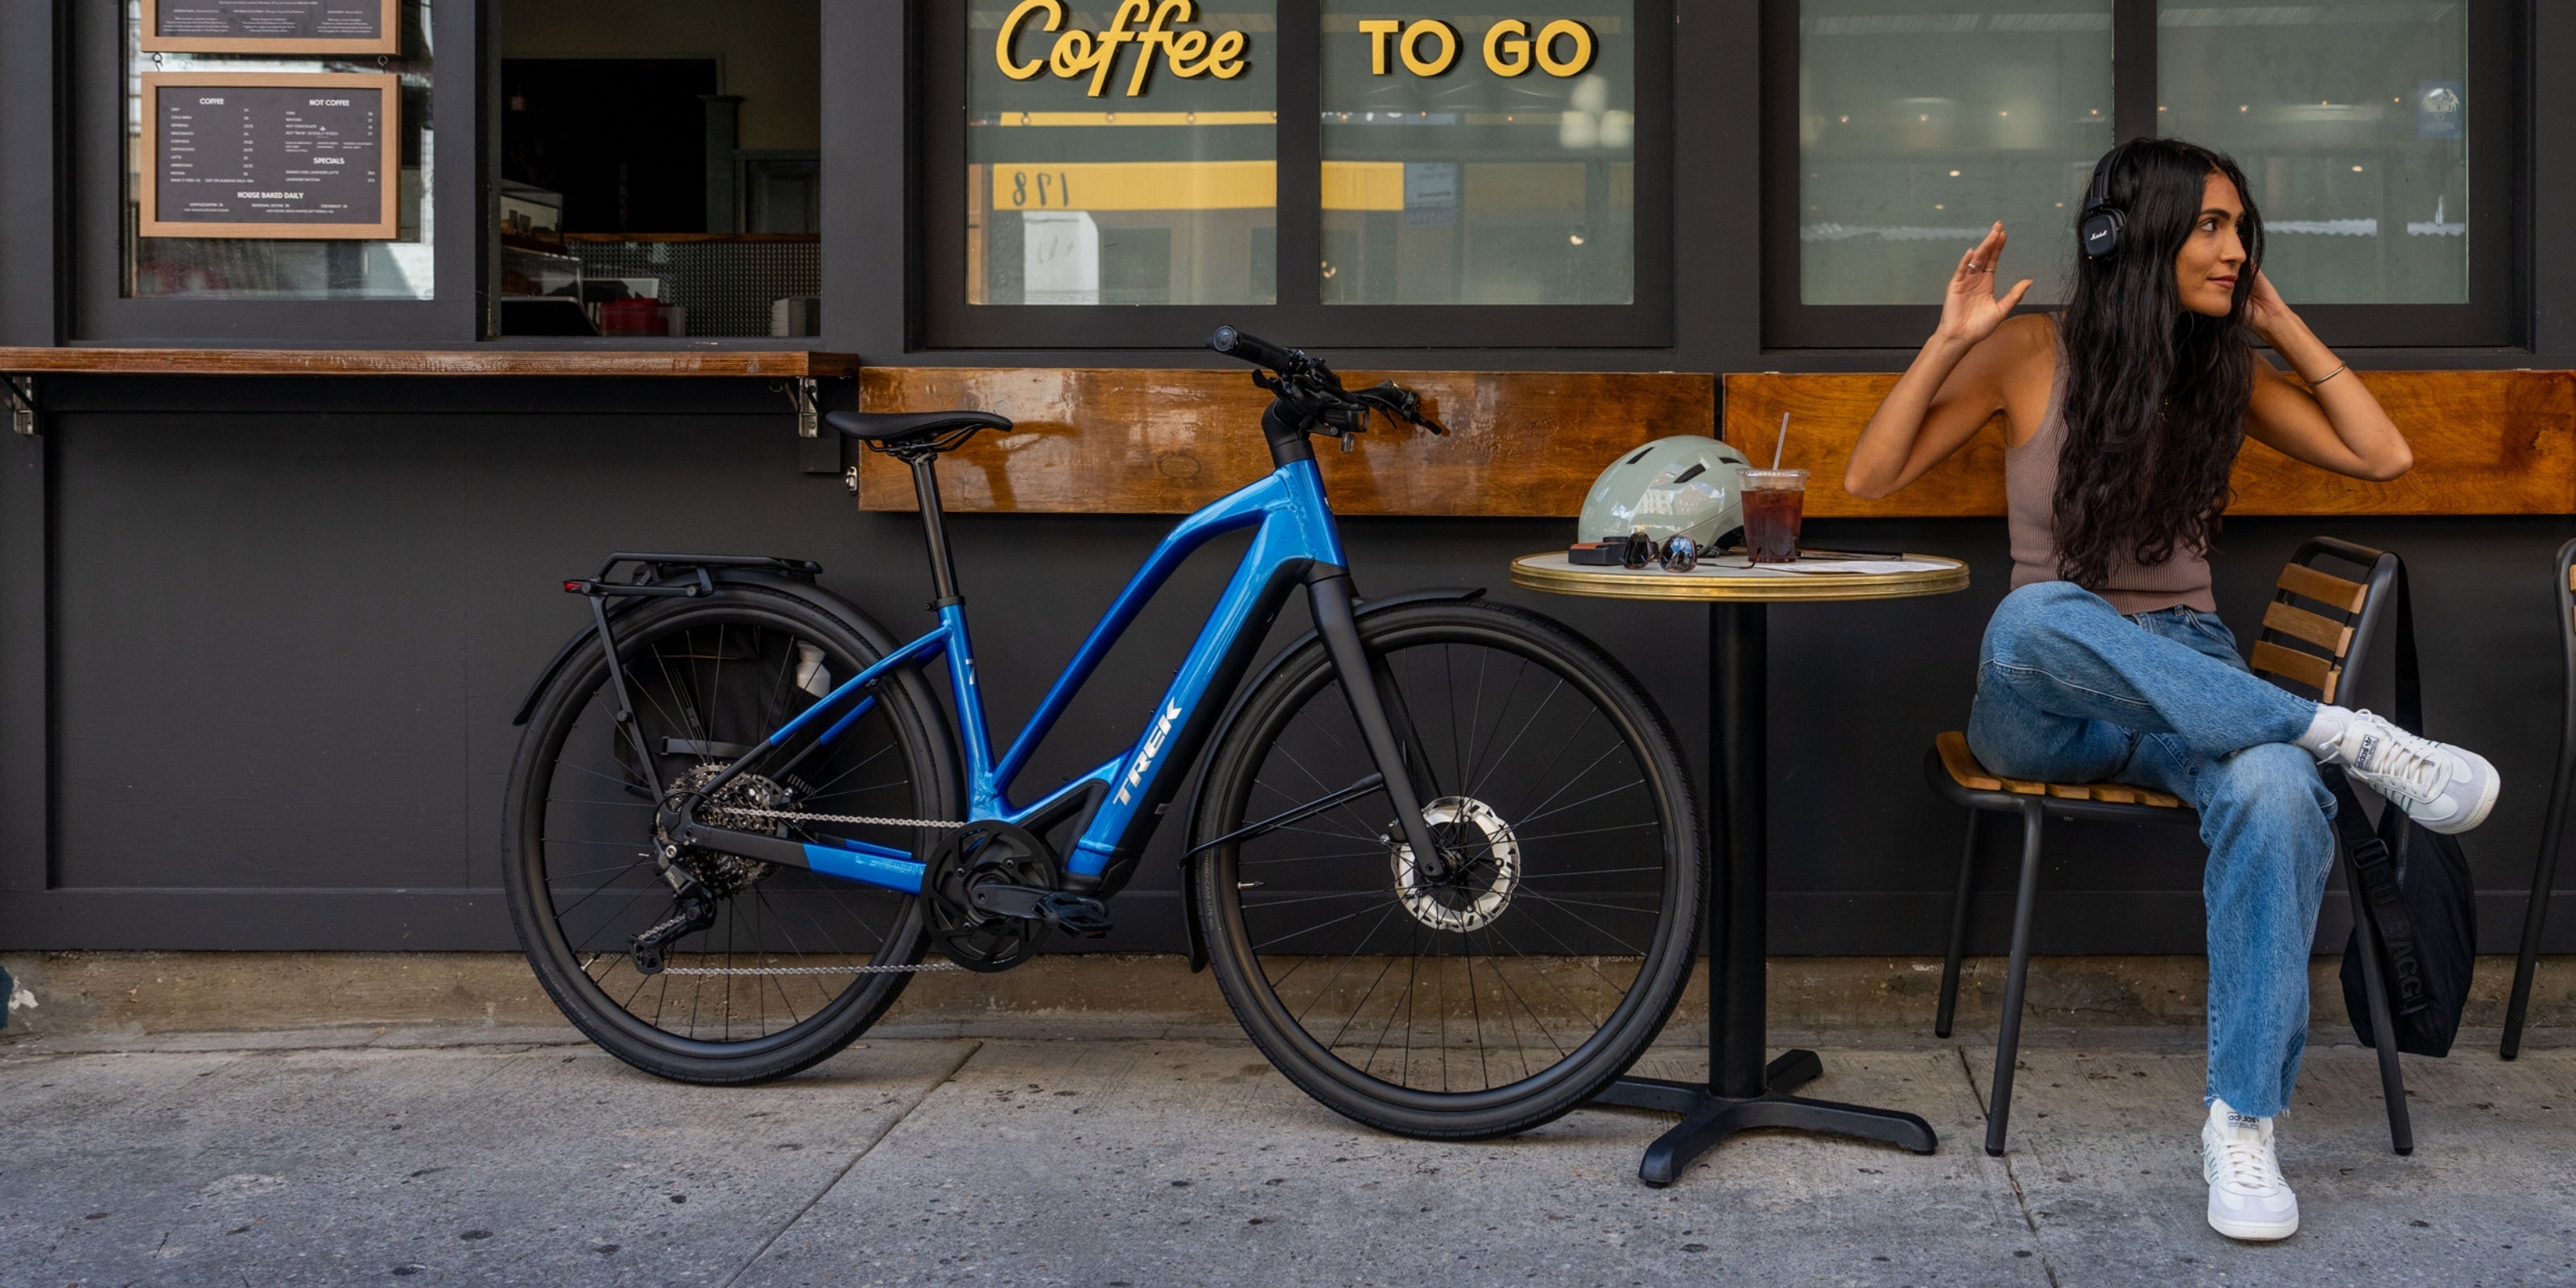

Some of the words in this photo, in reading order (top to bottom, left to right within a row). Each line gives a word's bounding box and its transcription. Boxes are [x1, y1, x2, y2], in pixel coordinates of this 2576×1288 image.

[996, 0, 1250, 97] Coffee
[1359, 19, 1462, 76] TO
[1483, 19, 1597, 76] GO
[313, 157, 345, 165] SPECIALS
[1113, 696, 1183, 806] TREK
